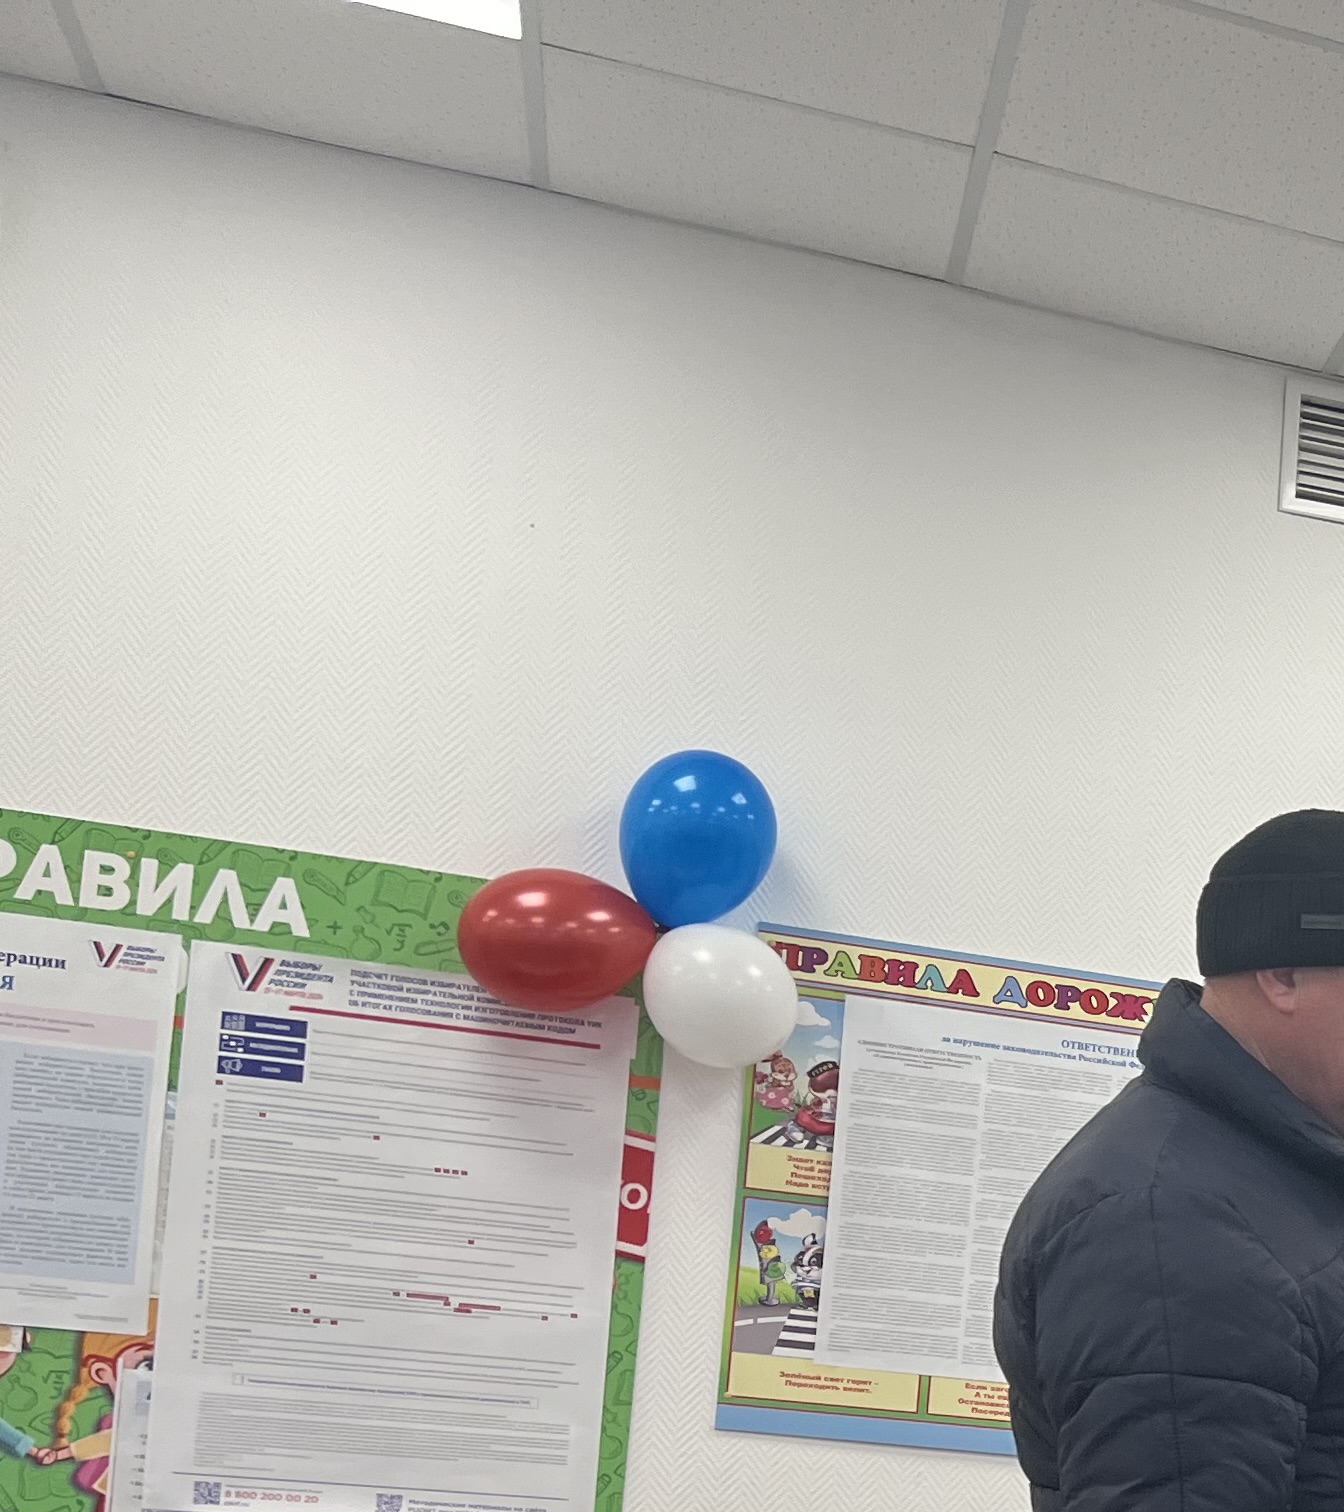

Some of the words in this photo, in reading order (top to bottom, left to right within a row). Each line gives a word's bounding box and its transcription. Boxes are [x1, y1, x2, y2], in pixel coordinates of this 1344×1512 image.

[774, 941, 981, 997] ПРАВИЛА
[992, 975, 1154, 1022] ДОРОЖ
[1061, 1040, 1138, 1058] ОТВЕТСТВЕН
[304, 1495, 319, 1503] 20
